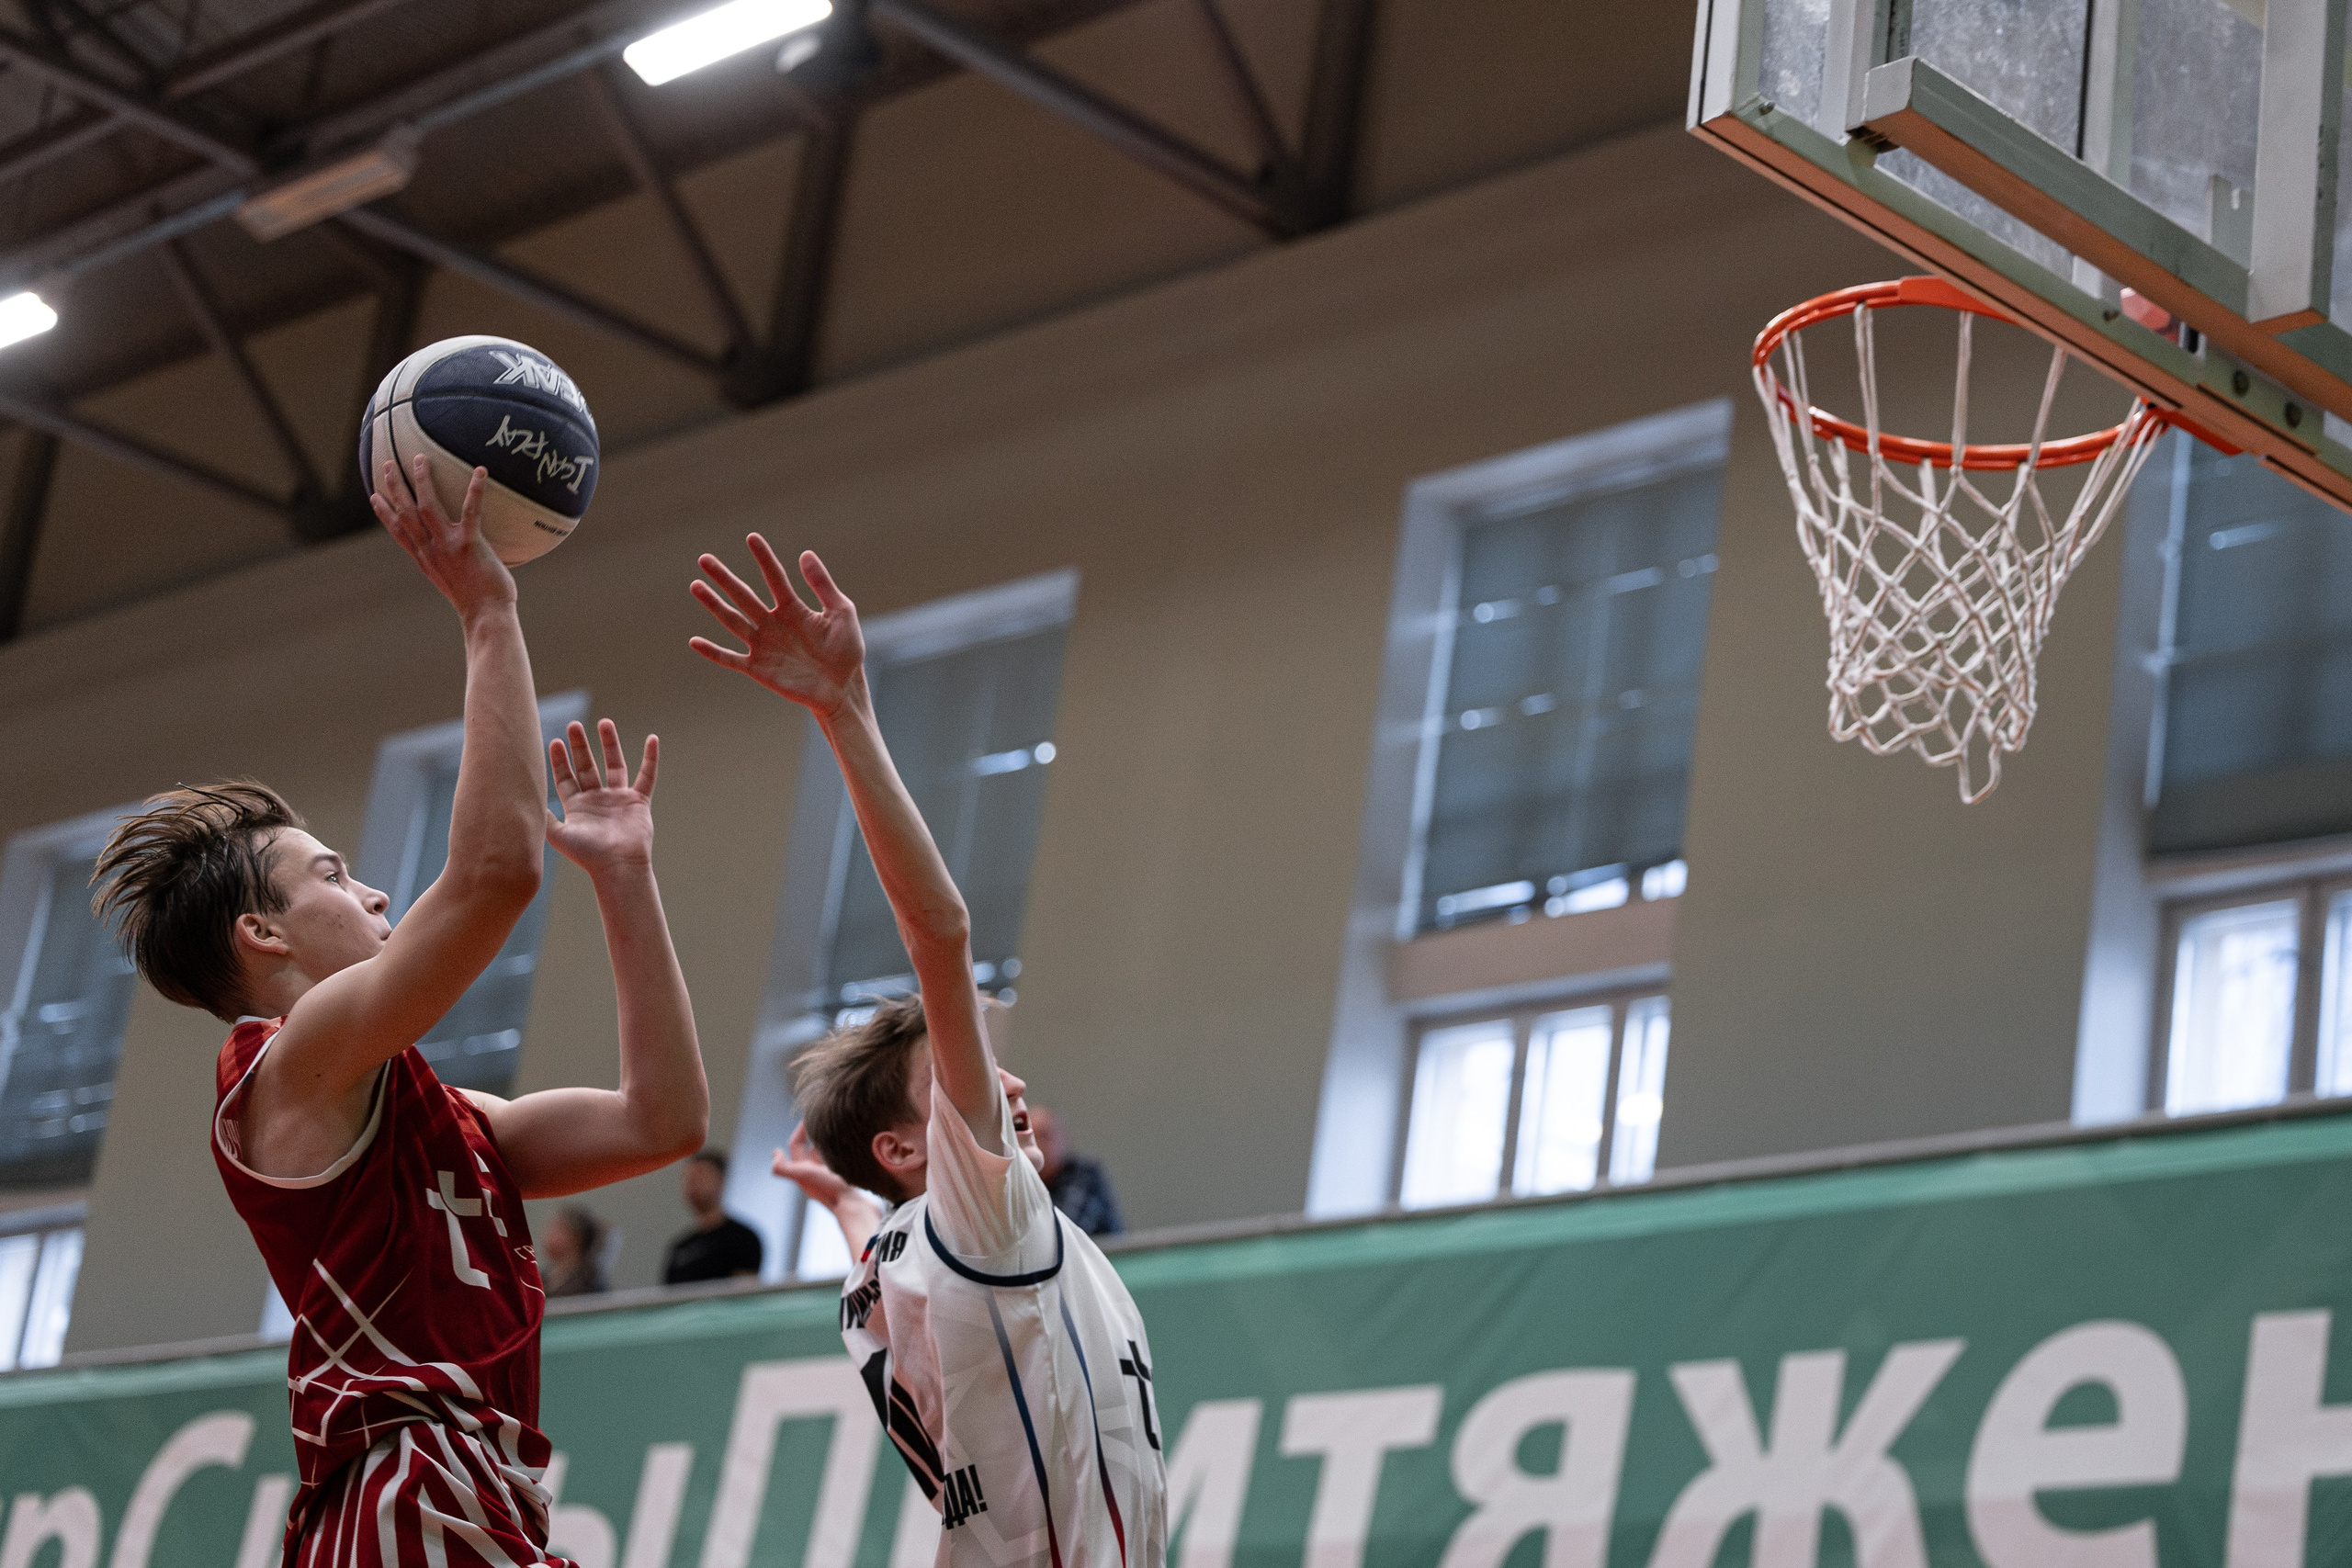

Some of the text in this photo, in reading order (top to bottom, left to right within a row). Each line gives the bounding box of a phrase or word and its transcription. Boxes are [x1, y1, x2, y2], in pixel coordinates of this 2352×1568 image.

[489, 350, 595, 430] EAK
[485, 414, 550, 460] PLAY
[537, 450, 576, 485] CAN
[941, 1463, 989, 1530] ДА!
